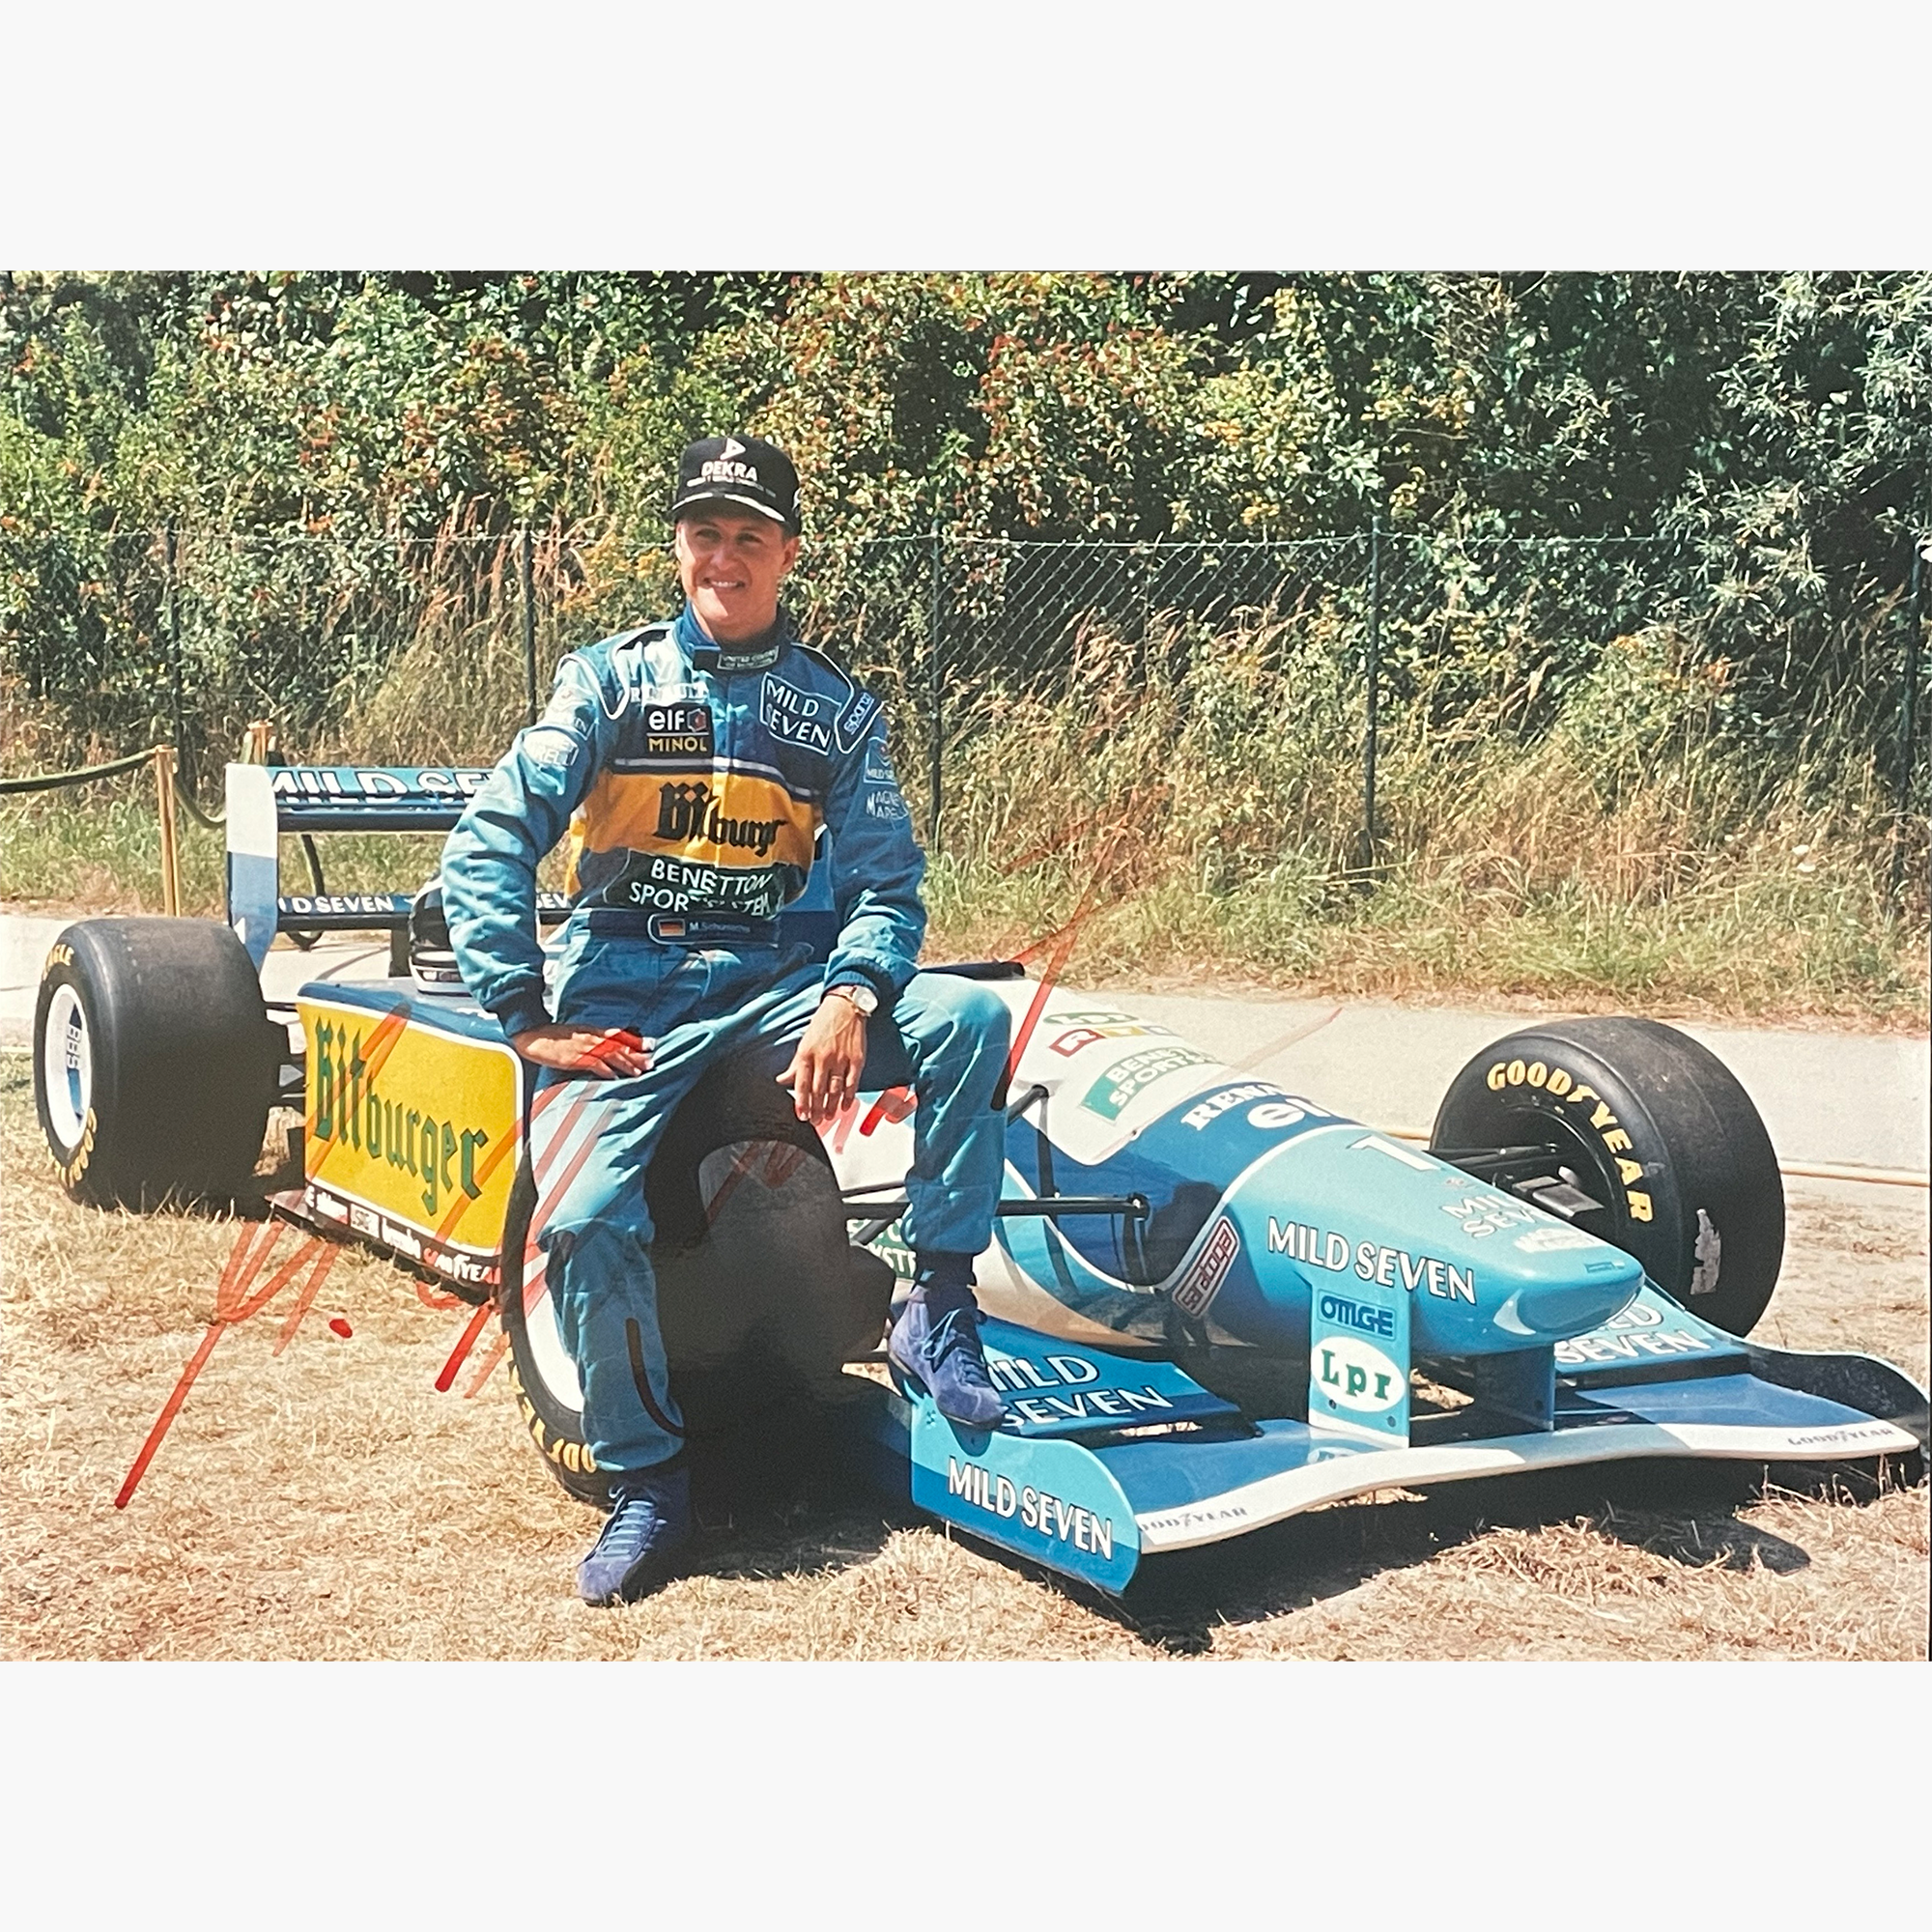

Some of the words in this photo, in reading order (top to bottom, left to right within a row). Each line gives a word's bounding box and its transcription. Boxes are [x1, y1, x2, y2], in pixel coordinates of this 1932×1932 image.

[701, 461, 758, 482] DEKRA
[767, 679, 819, 717] MILD
[648, 709, 685, 731] elf
[648, 736, 708, 753] MINOL
[651, 859, 774, 895] BENETTON
[315, 895, 395, 914] SEVEN
[315, 1016, 489, 1217] Bitburger
[1488, 1060, 1655, 1223] GOODYEAR
[1267, 1215, 1350, 1272] MILD
[1354, 1240, 1478, 1306] SEVEN
[1553, 1329, 1712, 1365] SEVEN
[1321, 1350, 1392, 1399] Lpr
[948, 1455, 1016, 1520] MILD
[1019, 1485, 1114, 1562] SEVEN
